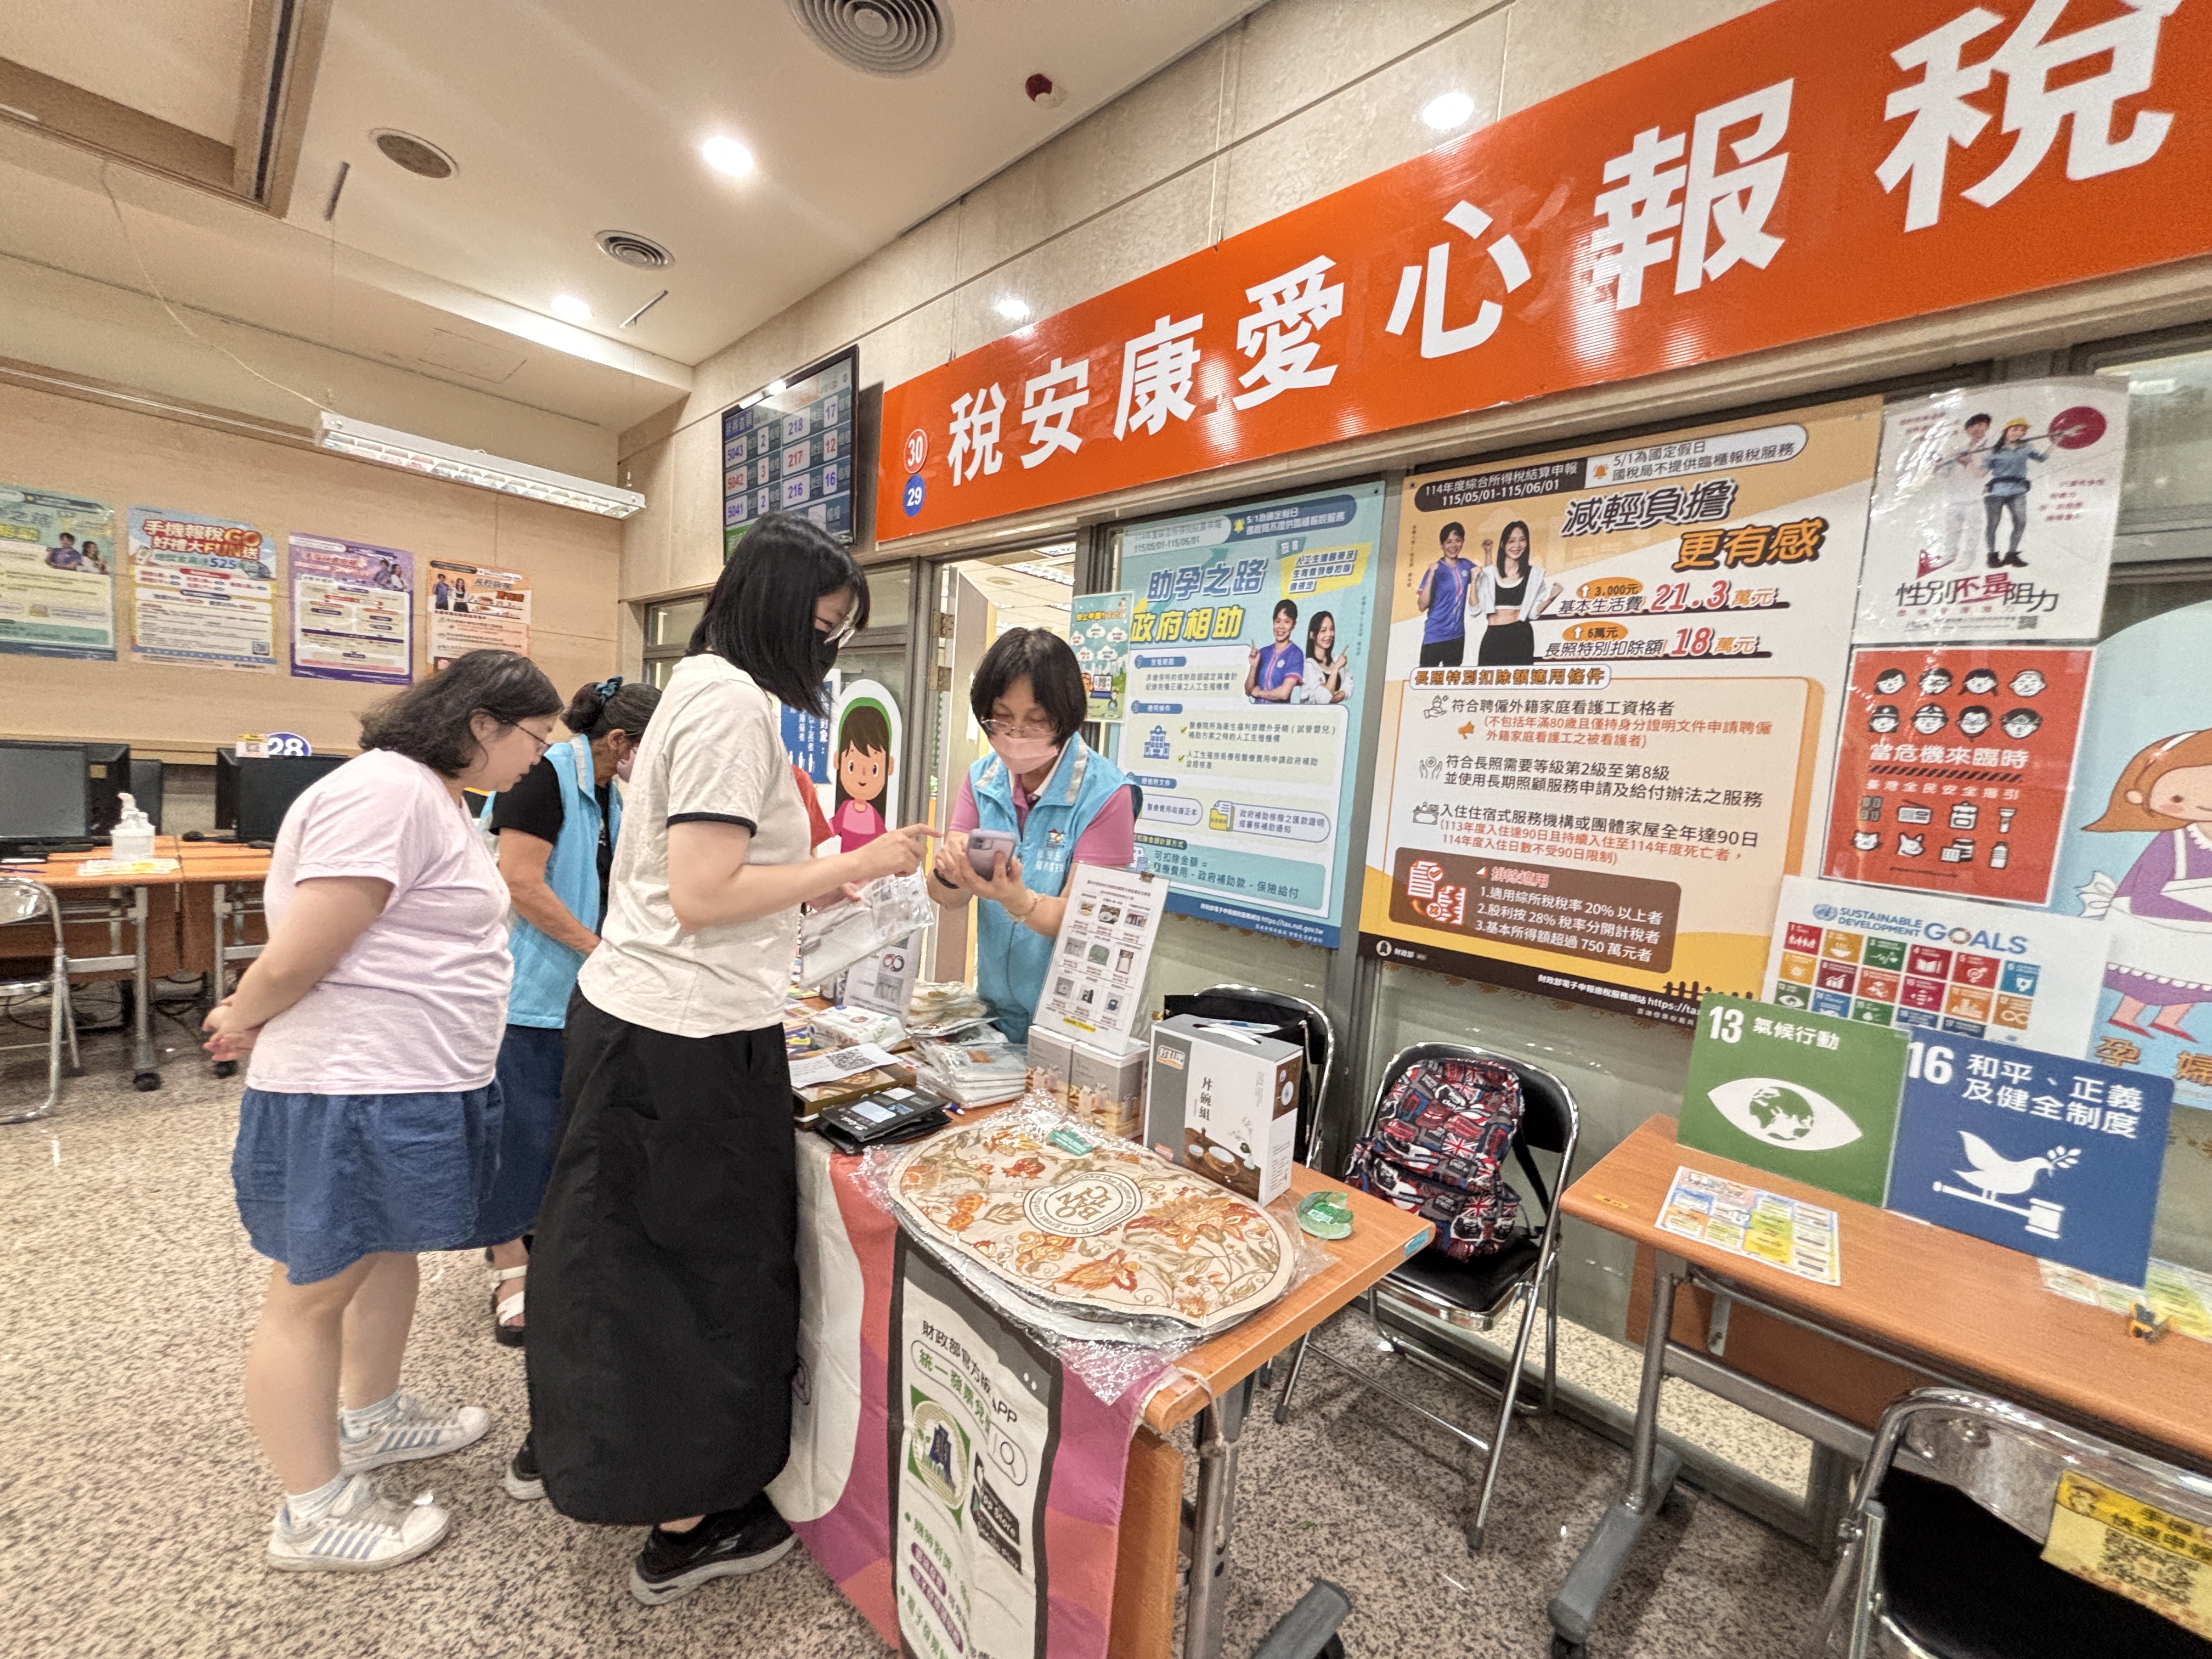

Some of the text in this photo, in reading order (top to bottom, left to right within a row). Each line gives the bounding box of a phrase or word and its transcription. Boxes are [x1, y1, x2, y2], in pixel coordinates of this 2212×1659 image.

[946, 0, 2183, 487] 稅安康愛心報稅
[825, 403, 837, 420] 17
[760, 434, 765, 447] 2
[788, 417, 804, 436] 218
[787, 450, 803, 467] 217
[825, 438, 836, 453] 12
[908, 436, 923, 466] 30
[1613, 441, 1706, 467] 5/1為國定假日
[760, 465, 765, 478] 3
[1612, 442, 1795, 482] 國稅局不提供臨櫃報稅服務
[788, 483, 803, 499] 216
[825, 472, 836, 487] 16
[1426, 462, 1577, 496] 114年度綜合所得稅結算申報
[1442, 479, 1559, 506] 115/05/01-115/06/01
[760, 495, 765, 507] 2
[908, 487, 922, 507] 29
[1561, 478, 1737, 537] 減輕負擔
[1673, 516, 1829, 571] 更有感
[1148, 557, 1269, 602] 助孕之路
[1895, 573, 2059, 613] 性別不是阻力
[1558, 596, 1644, 615] 基本生活費
[1650, 579, 1730, 612] 21.3
[1131, 606, 1246, 643] 政府相助
[1544, 640, 1664, 658] 長照特別扣除額
[1671, 628, 1712, 656] 18
[1414, 668, 1606, 686] 長照特別扣除額適用條件
[1451, 699, 1675, 717] 符合聘僱外籍家庭看護工資格者
[268, 737, 303, 756] 28
[1870, 743, 2029, 769] 當危機來臨時
[1446, 755, 1670, 781] 符合長照需要等級第2級至第8級
[1444, 772, 1764, 808] 並使用長期照顧服務申請及給付辦法之服務
[1440, 803, 1758, 847] 入住住宿式服務機構或團體家屋全年達90日
[1477, 902, 1660, 945] 2.股利按 28% 稅率分開計稅者
[1585, 902, 1615, 918] 20%
[1617, 906, 1663, 926] 以上者
[1839, 907, 1923, 929] SUSTAINABLE
[1475, 920, 1653, 963] 3.基本所得額超過 750 萬元者
[1838, 917, 2028, 955] DEVELOPMENT GOALS
[1708, 1005, 1743, 1044] 13
[1753, 1016, 1841, 1051] 氣候行動
[1908, 1041, 2143, 1113] 16 和平、正義
[1962, 1078, 2139, 1139] 及健全制度
